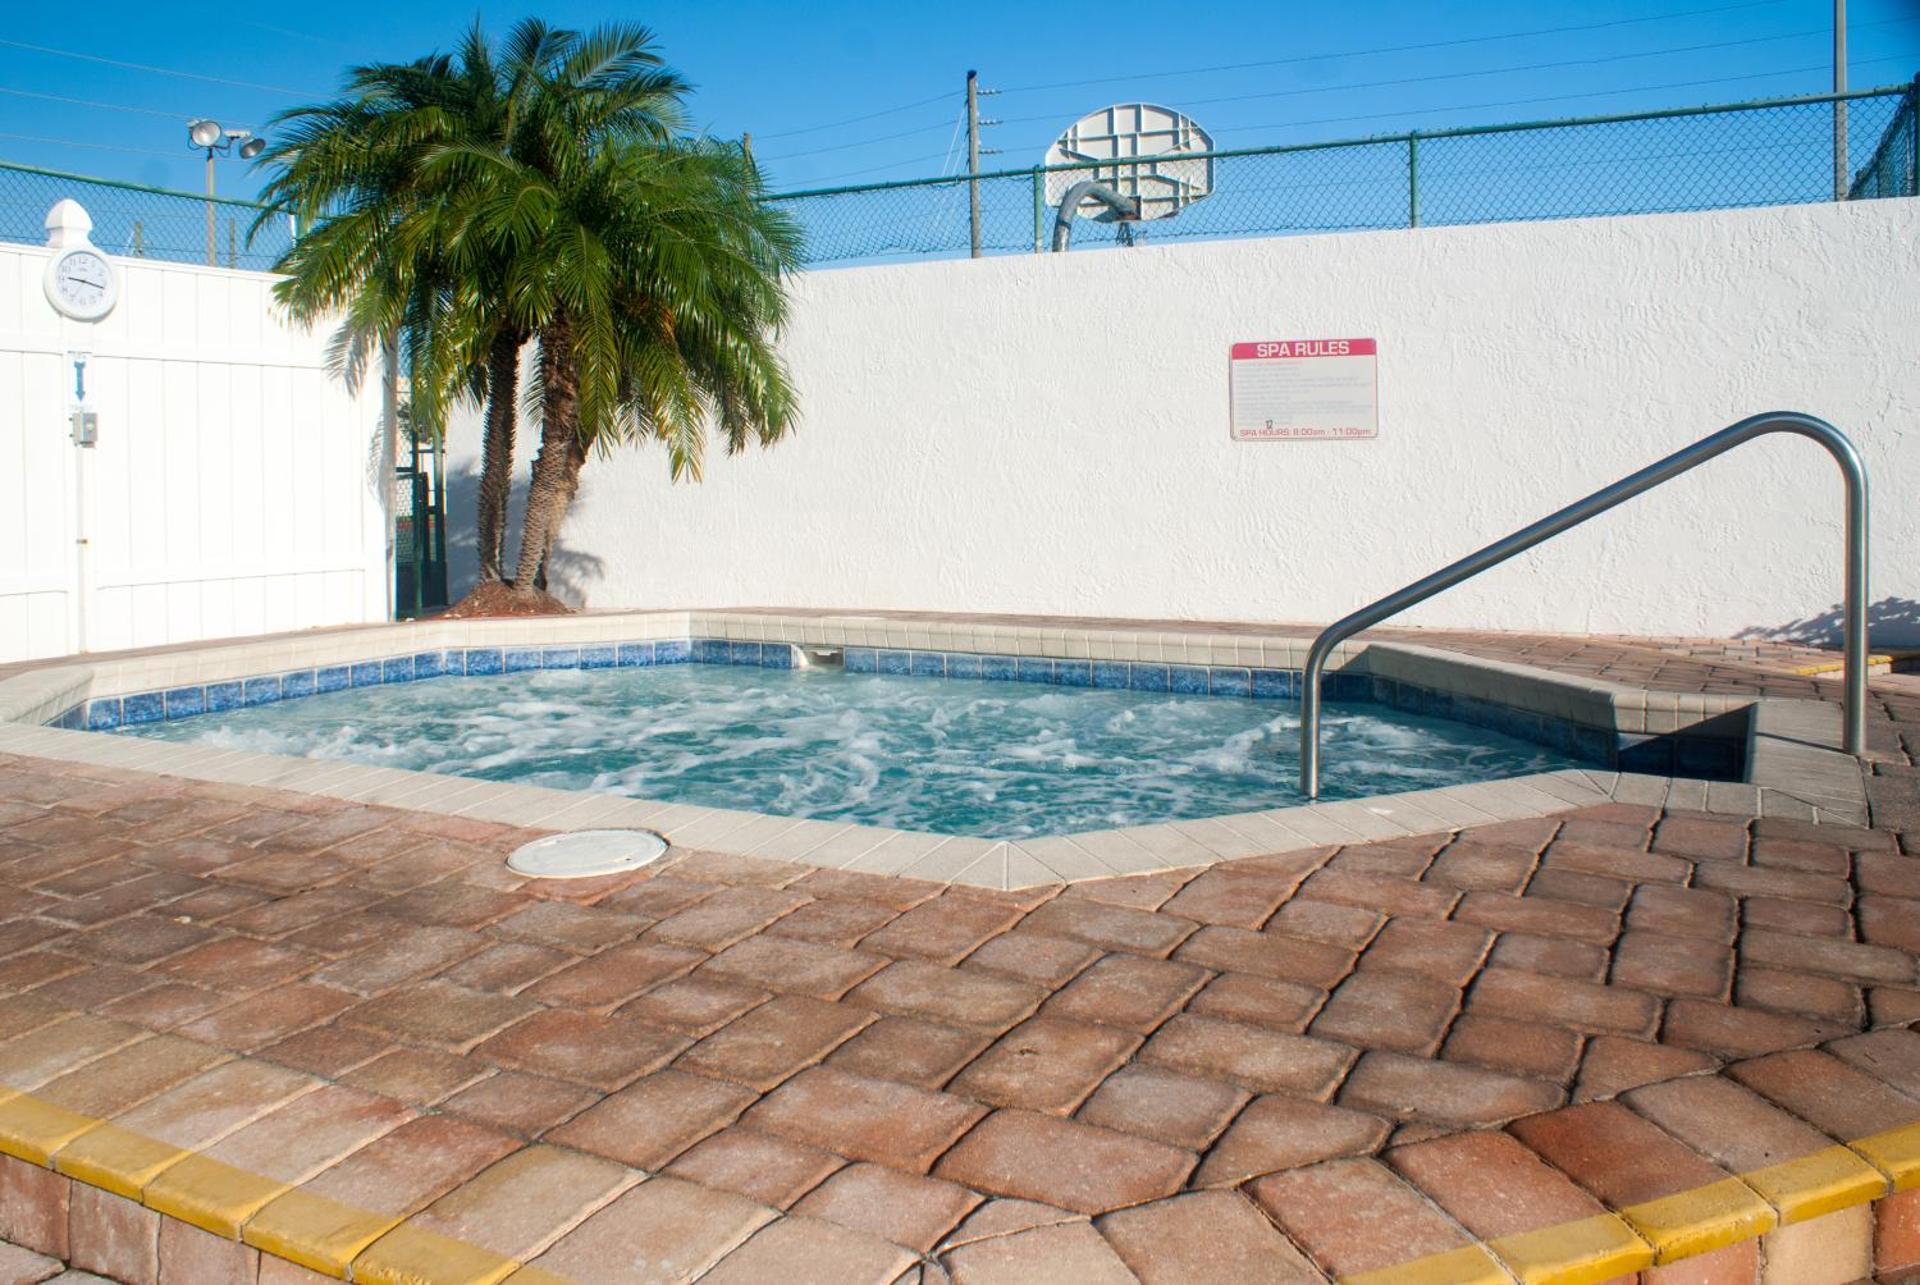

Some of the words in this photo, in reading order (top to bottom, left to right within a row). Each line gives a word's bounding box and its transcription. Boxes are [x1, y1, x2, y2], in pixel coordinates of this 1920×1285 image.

[79, 255, 88, 265] 12
[1257, 343, 1291, 357] SPA
[1295, 341, 1350, 356] RULES
[1239, 429, 1257, 437] SPA
